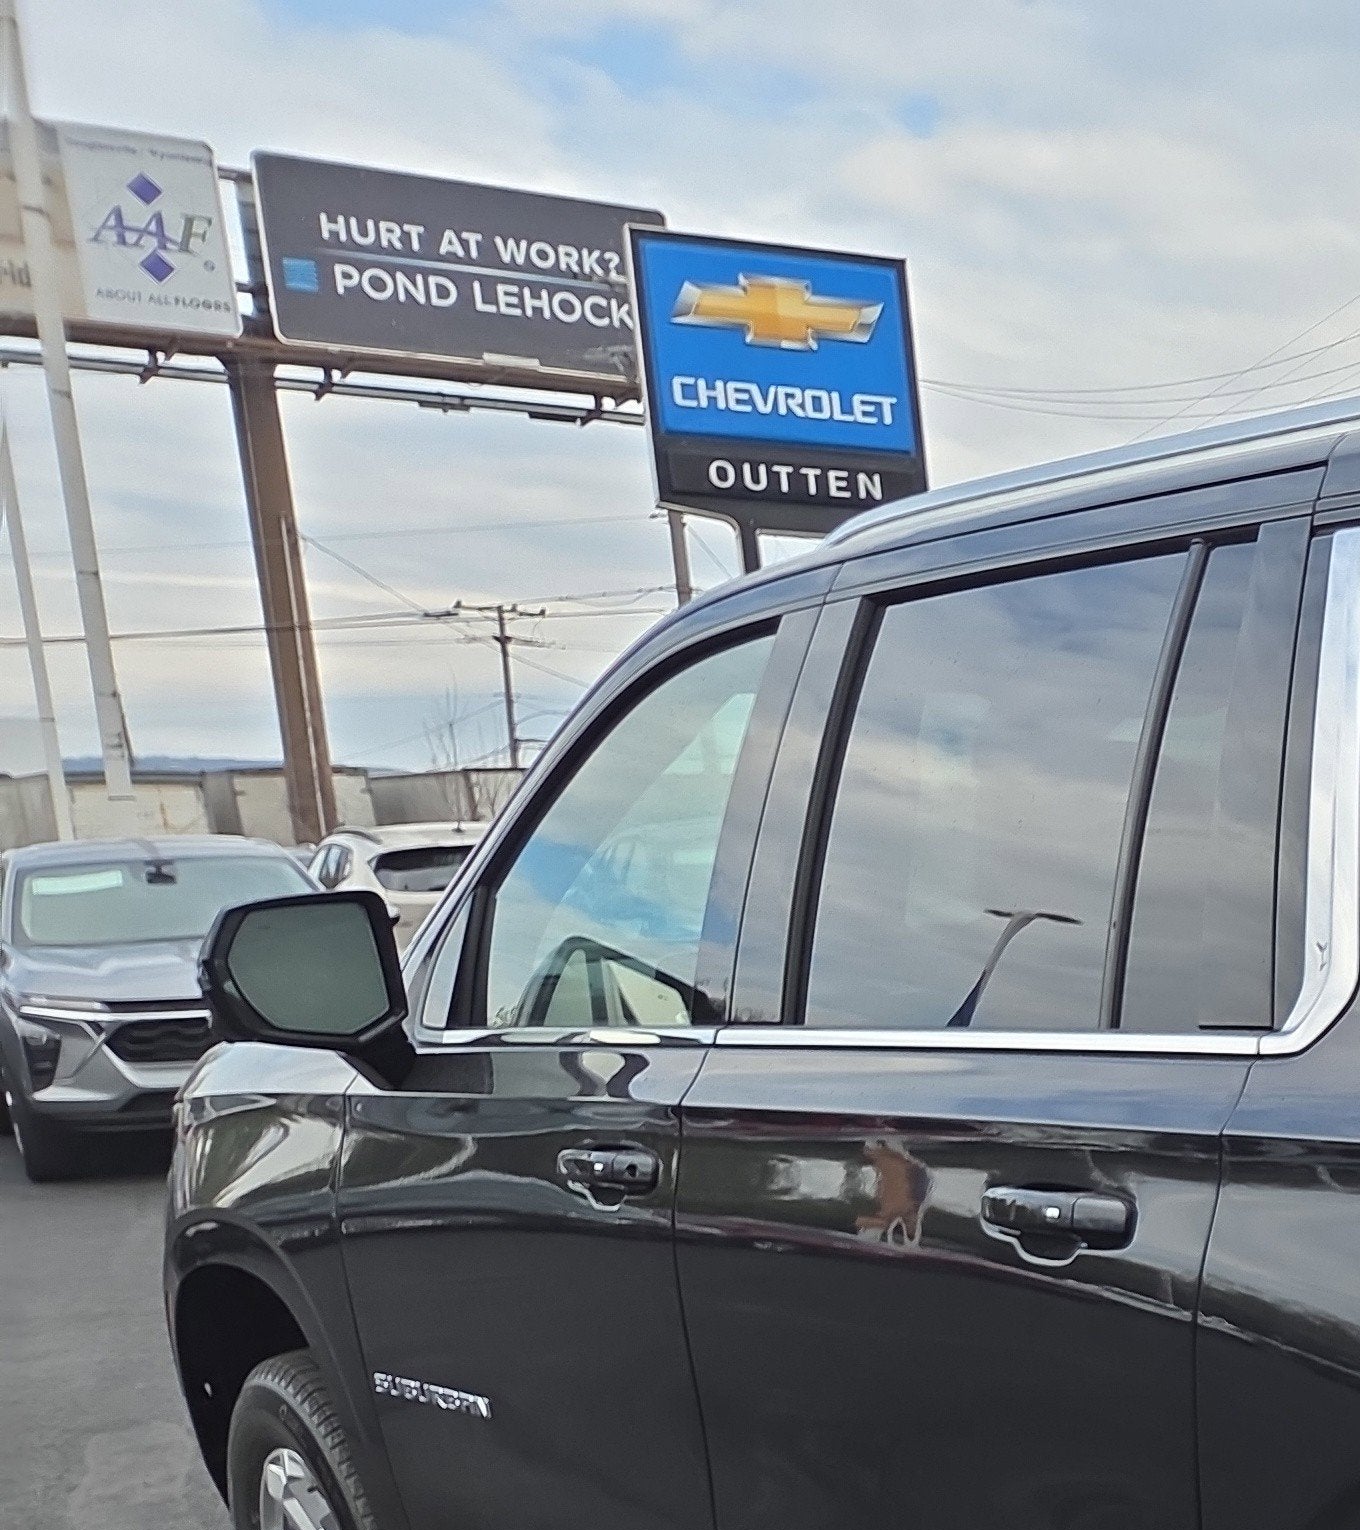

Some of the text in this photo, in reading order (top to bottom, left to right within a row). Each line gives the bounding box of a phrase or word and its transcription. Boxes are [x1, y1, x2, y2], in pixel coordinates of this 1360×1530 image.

[88, 204, 214, 257] AAF
[318, 211, 622, 281] HURT AT WORK?
[96, 288, 142, 303] ABOUT
[333, 262, 458, 308] POND
[671, 374, 898, 426] CHEVROLET
[707, 459, 883, 501] OUTTEN
